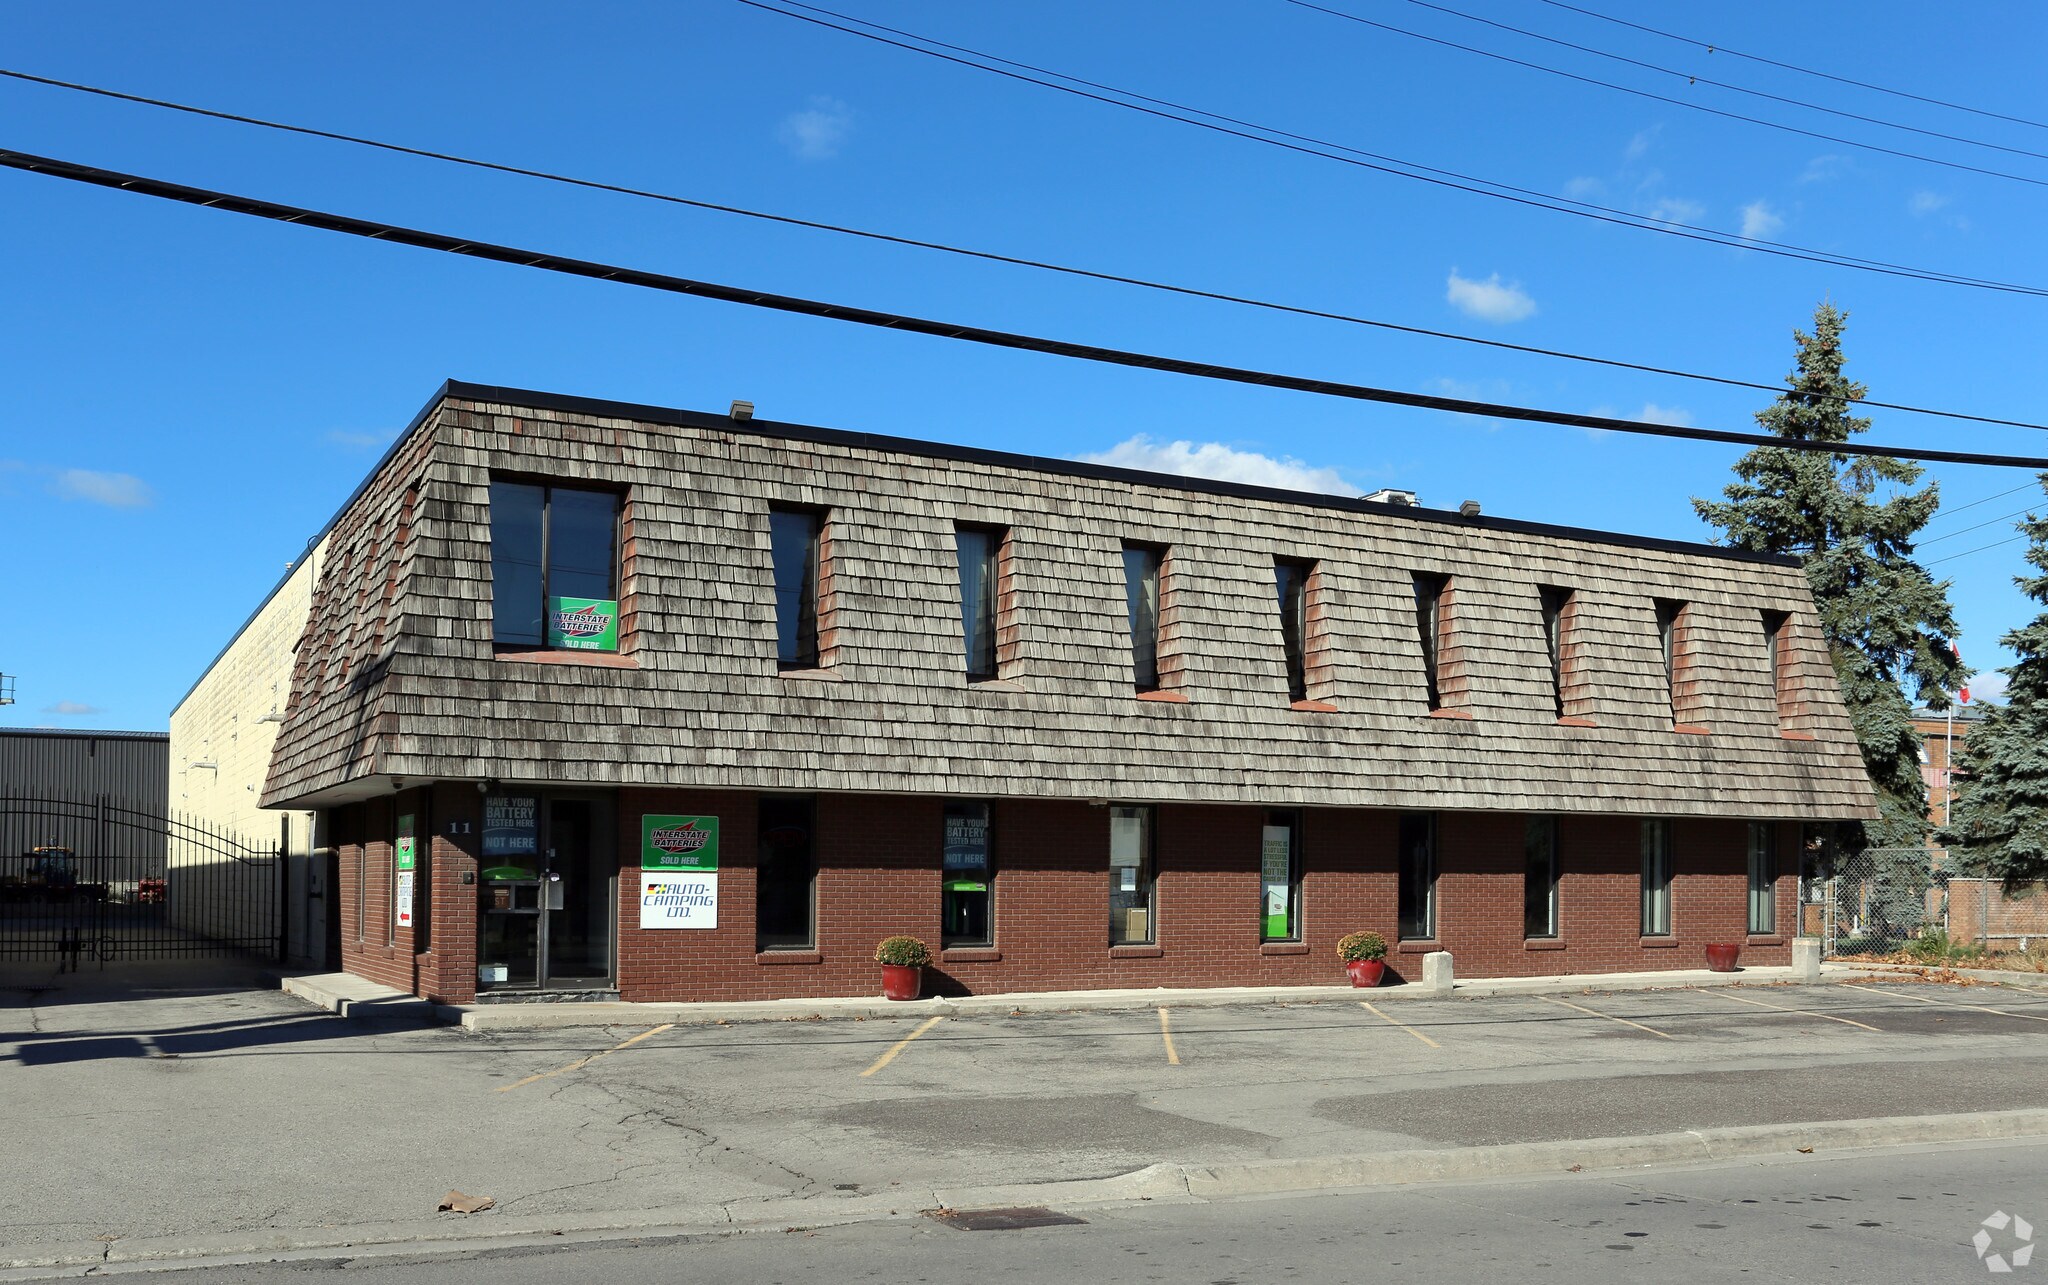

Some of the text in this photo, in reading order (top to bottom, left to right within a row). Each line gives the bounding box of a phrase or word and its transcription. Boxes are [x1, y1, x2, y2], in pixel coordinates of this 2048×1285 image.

[552, 612, 609, 624] INTERSTATE
[554, 622, 604, 632] BATTERIES
[561, 640, 600, 650] SOLD HERE
[486, 797, 535, 807] HAVE YOUR
[486, 807, 535, 819] BATTERY
[487, 819, 535, 828] TESTED HERE
[946, 818, 985, 828] HAVE YOUR
[653, 830, 708, 839] INTERSTATE
[946, 827, 985, 838] BATTERY
[485, 837, 535, 849] NOT HERE
[654, 839, 704, 847] BATTERIES
[947, 837, 985, 846] TESTED HERE
[660, 856, 700, 865] SOLD HERE
[946, 853, 985, 864] NOT HERE
[667, 883, 710, 895] AUTO-
[643, 895, 715, 906] CAMPING
